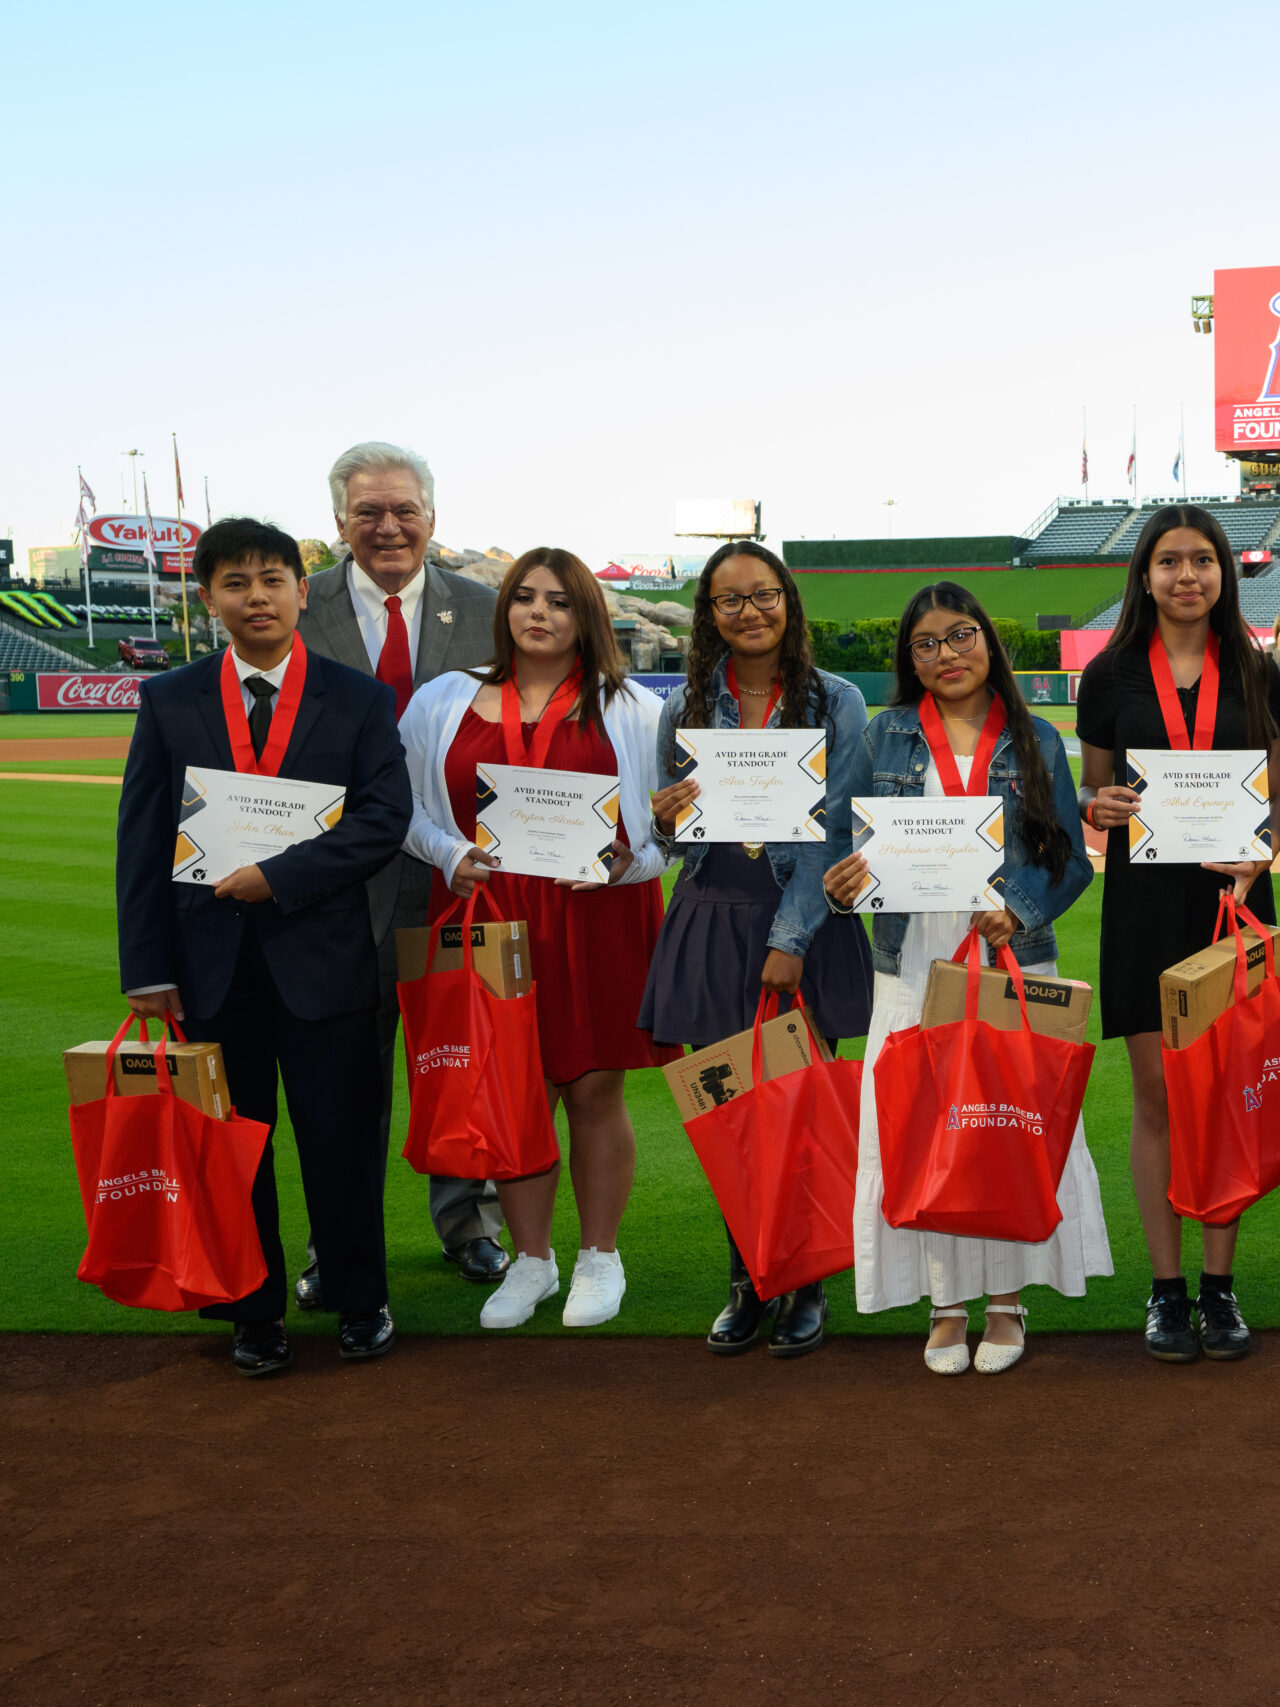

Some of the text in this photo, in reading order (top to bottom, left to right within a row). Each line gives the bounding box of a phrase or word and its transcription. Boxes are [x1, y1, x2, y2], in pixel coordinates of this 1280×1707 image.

[10, 673, 25, 682] 390
[57, 676, 141, 706] Coca-Col
[718, 775, 783, 790] Ava Taylor
[514, 786, 535, 794] AVID
[555, 790, 584, 800] GRADE
[227, 794, 307, 810] AVID 8TH GRADE
[525, 796, 572, 807] STANDOUT
[239, 805, 293, 818] STANDOUT
[509, 808, 546, 824] Peyton
[915, 818, 933, 826] 8TH
[935, 818, 966, 826] GRADE
[444, 930, 482, 942] Leovo
[416, 1045, 470, 1062] NGELS BASE
[793, 1034, 810, 1067] chromeboo
[125, 1058, 174, 1072] Lnovo
[690, 1082, 707, 1111] UN3481
[961, 1103, 1042, 1121] ANGELS BASEBA
[961, 1117, 1047, 1136] FOUNDATIO
[98, 1170, 148, 1188] ANGELS
